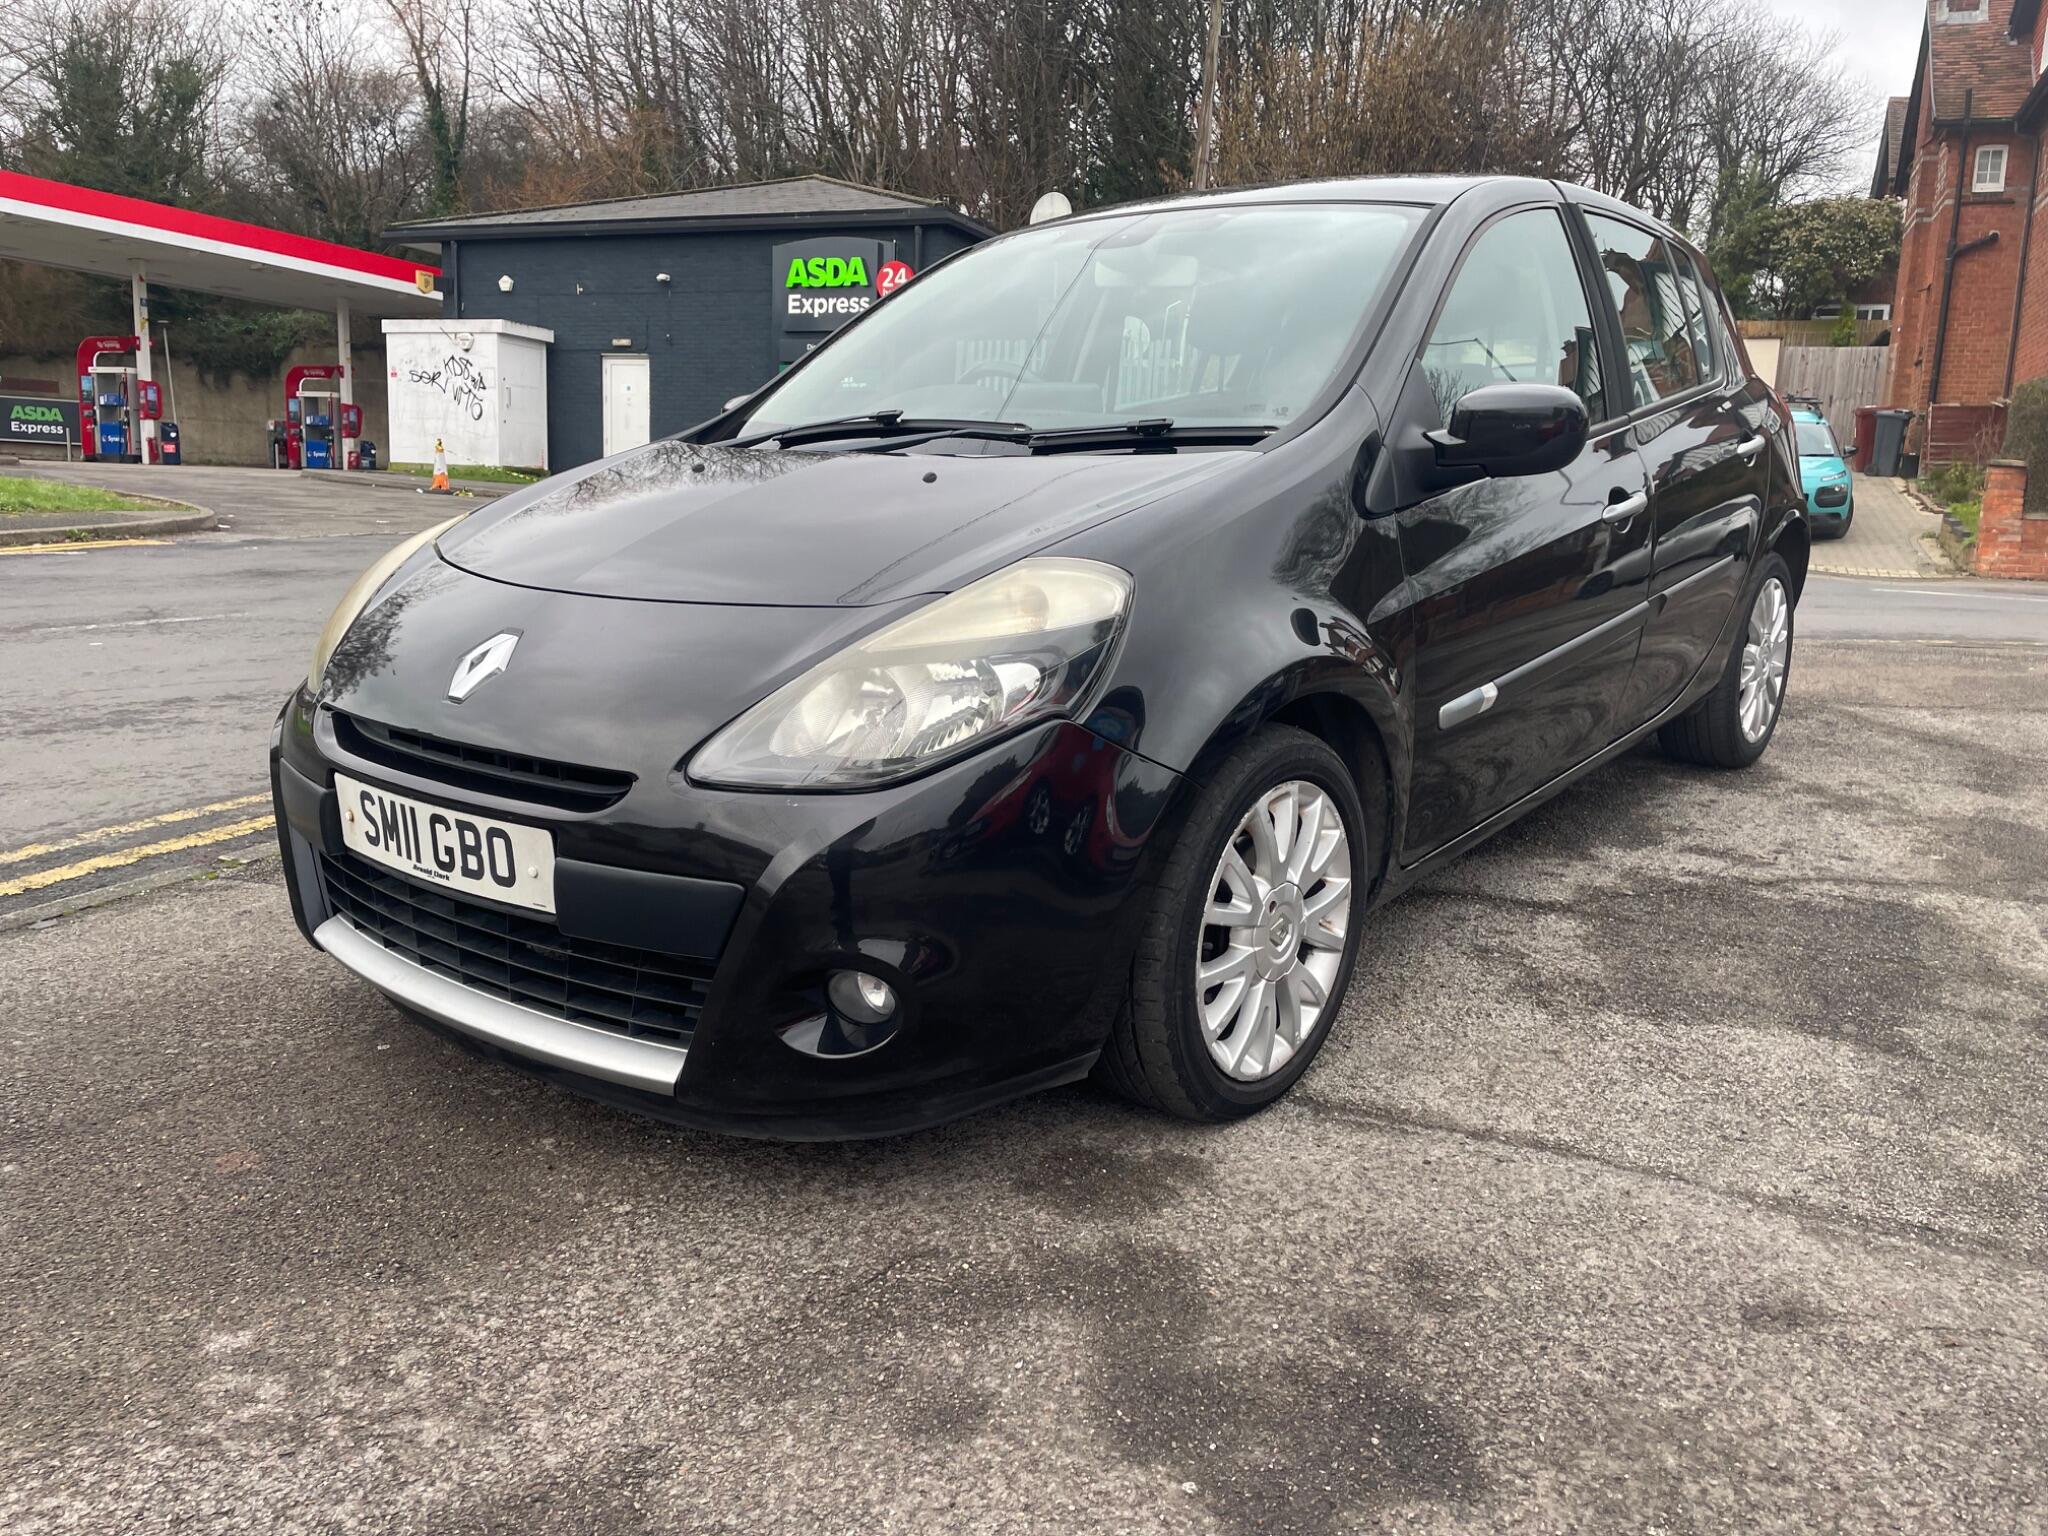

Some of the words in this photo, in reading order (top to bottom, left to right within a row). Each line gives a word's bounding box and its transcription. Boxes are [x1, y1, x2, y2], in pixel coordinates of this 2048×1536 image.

[786, 257, 868, 288] ASDA
[882, 267, 907, 287] 24
[788, 294, 870, 317] Express
[10, 405, 64, 422] ASDA
[10, 421, 64, 434] Express
[359, 790, 422, 864] SM11
[429, 813, 517, 888] GBO
